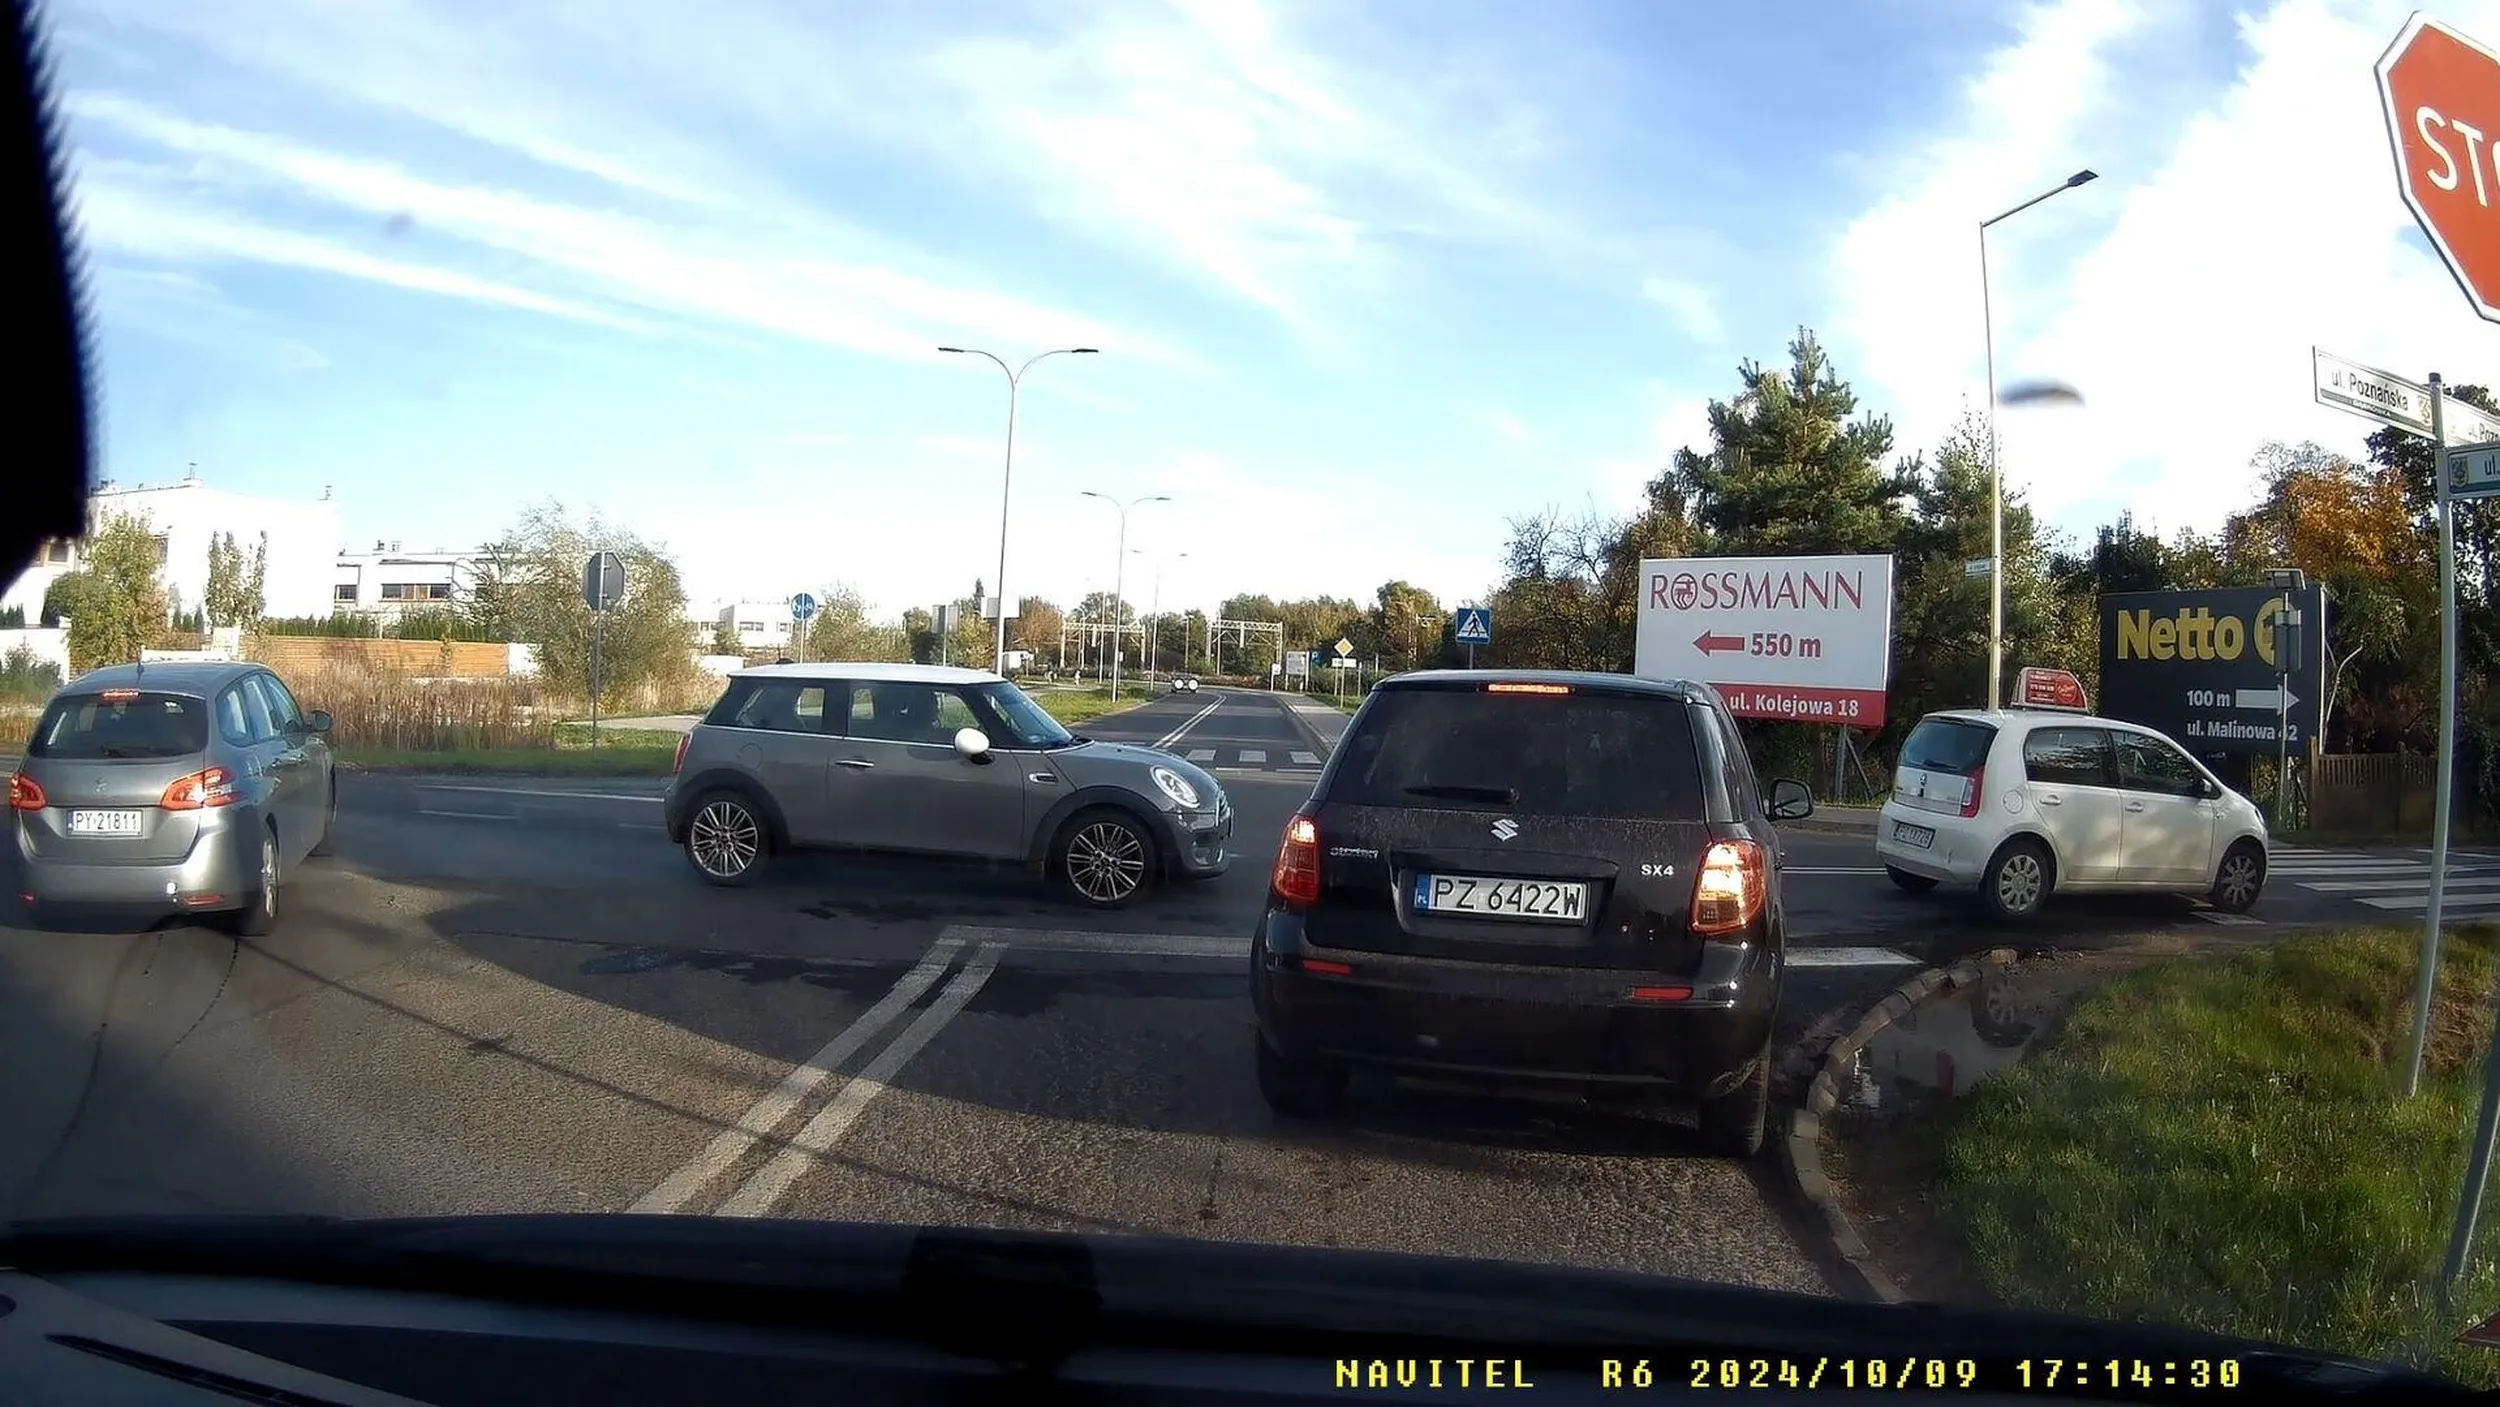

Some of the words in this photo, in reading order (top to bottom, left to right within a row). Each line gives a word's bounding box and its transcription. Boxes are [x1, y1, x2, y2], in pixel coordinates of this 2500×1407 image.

[2415, 105, 2500, 208] ST
[2331, 369, 2346, 389] ul.
[2349, 372, 2409, 412] Poznańska
[1650, 571, 1863, 611] ROSSMANN
[1751, 633, 1792, 656] 550
[1799, 637, 1821, 657] m
[2116, 607, 2245, 660] Netto
[1730, 693, 1750, 710] ul.
[1756, 696, 1833, 717] Kolejowa
[1838, 699, 1859, 716] 18
[2186, 690, 2213, 706] 100
[2216, 693, 2230, 706] m
[2187, 720, 2204, 736] ul.
[2207, 720, 2275, 740] Malinowa
[76, 812, 92, 829] PY
[97, 812, 136, 829] 21811
[1641, 863, 1675, 877] SX4
[1434, 878, 1477, 909] PZ
[1488, 882, 1581, 916] 6422W
